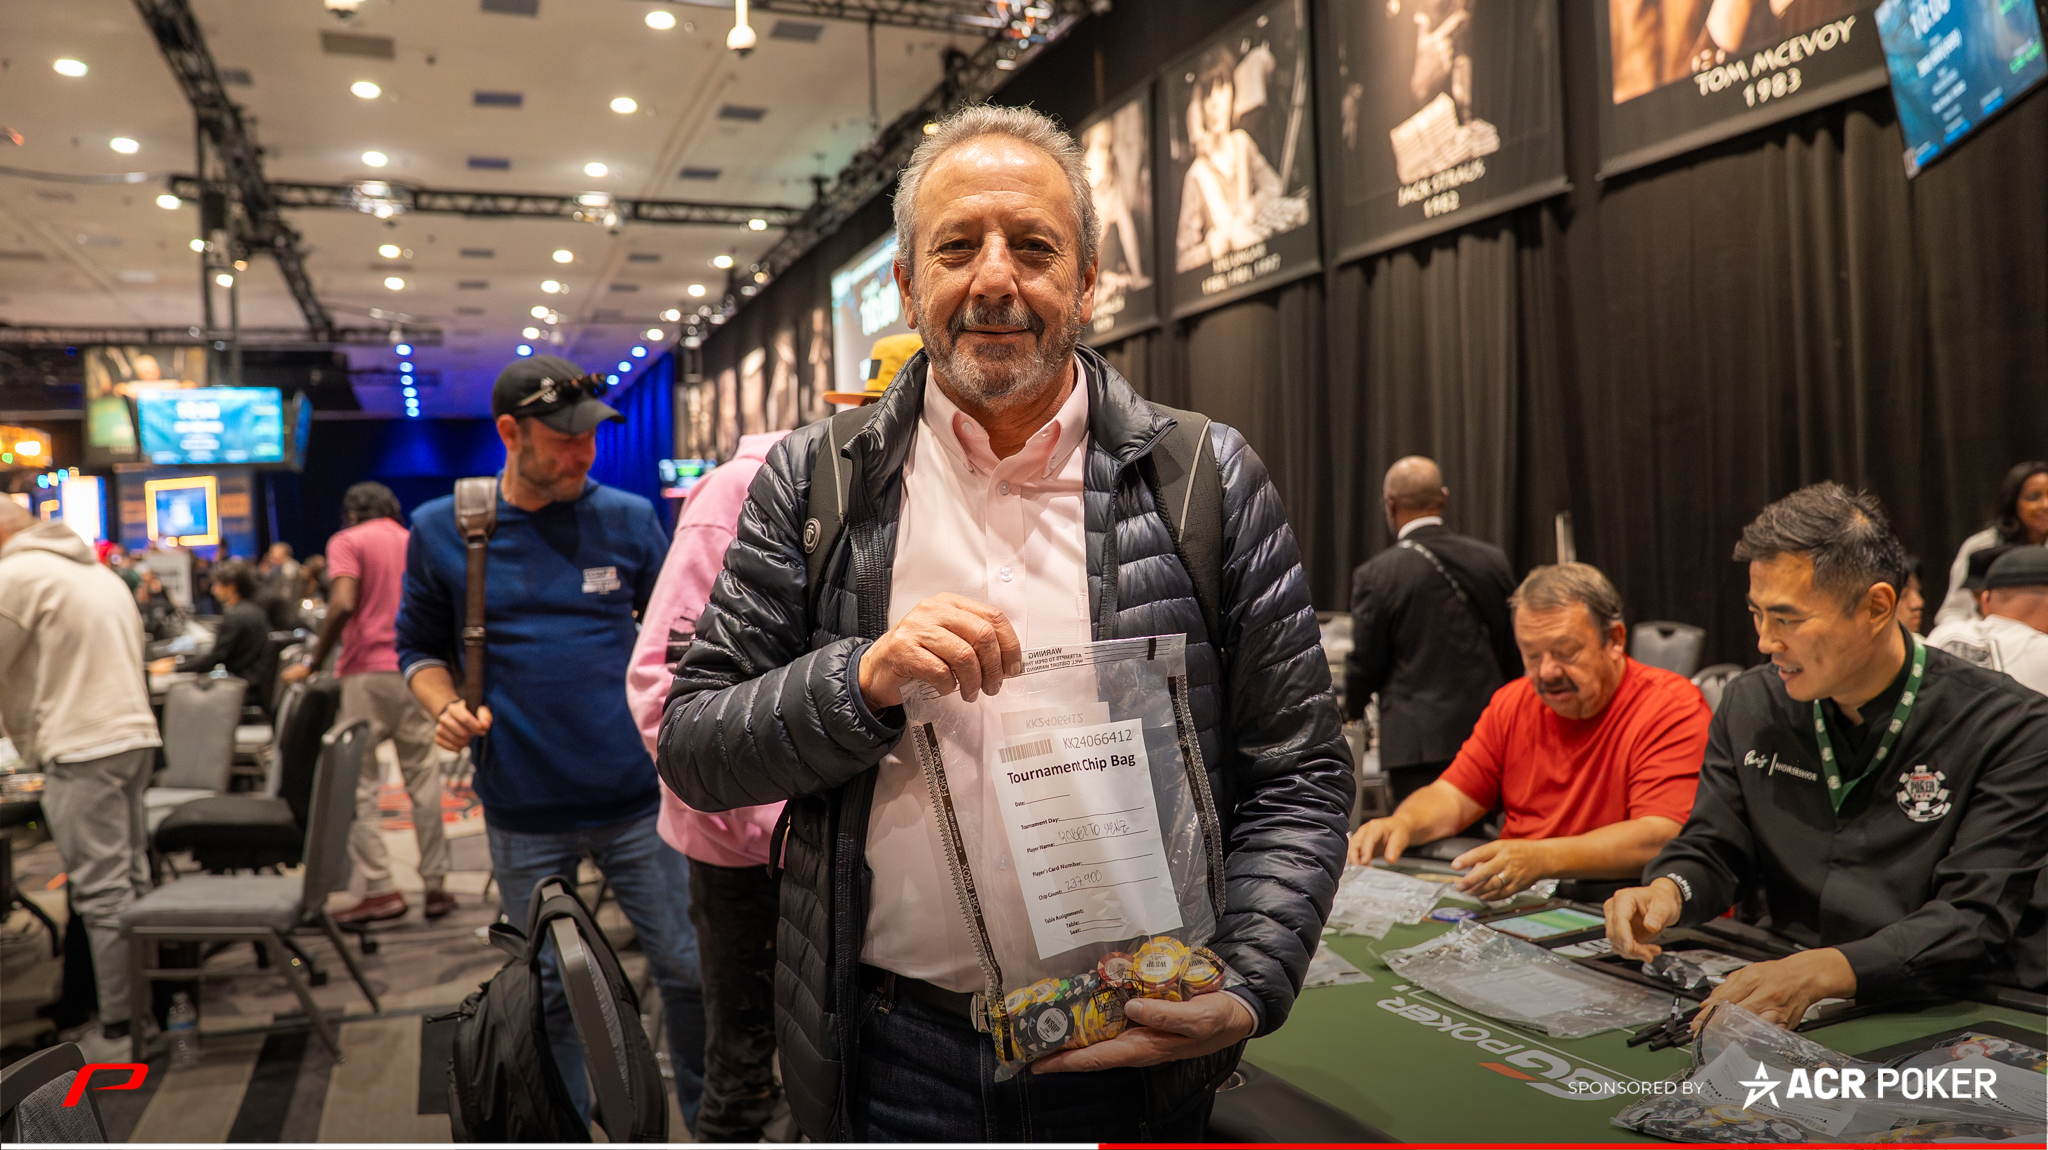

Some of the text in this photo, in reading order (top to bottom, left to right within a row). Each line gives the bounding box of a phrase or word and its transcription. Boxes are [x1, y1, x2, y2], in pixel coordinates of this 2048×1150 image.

[1693, 15, 1857, 96] TOM MCEVOY
[1743, 67, 1802, 107] 1983
[1423, 190, 1460, 218] 1982
[1173, 698, 1188, 749] FORT KNOX
[1063, 729, 1132, 749] KK24066412
[931, 745, 949, 797] FORT KNOX
[1007, 754, 1136, 785] Tournament Chip Bag
[1911, 781, 1935, 793] POKER
[1021, 817, 1060, 830] Tournament Day:
[1027, 842, 1056, 854] Player Name:
[1199, 812, 1213, 866] FORT KNOX
[1048, 865, 1060, 873] Card
[1060, 861, 1083, 870] Number:
[961, 863, 981, 917] FORT KNOX
[1038, 889, 1063, 901] Chip Count:
[1055, 908, 1085, 921] Assignment:
[1066, 920, 1080, 928] Table:
[1044, 1016, 1061, 1033] WSOP
